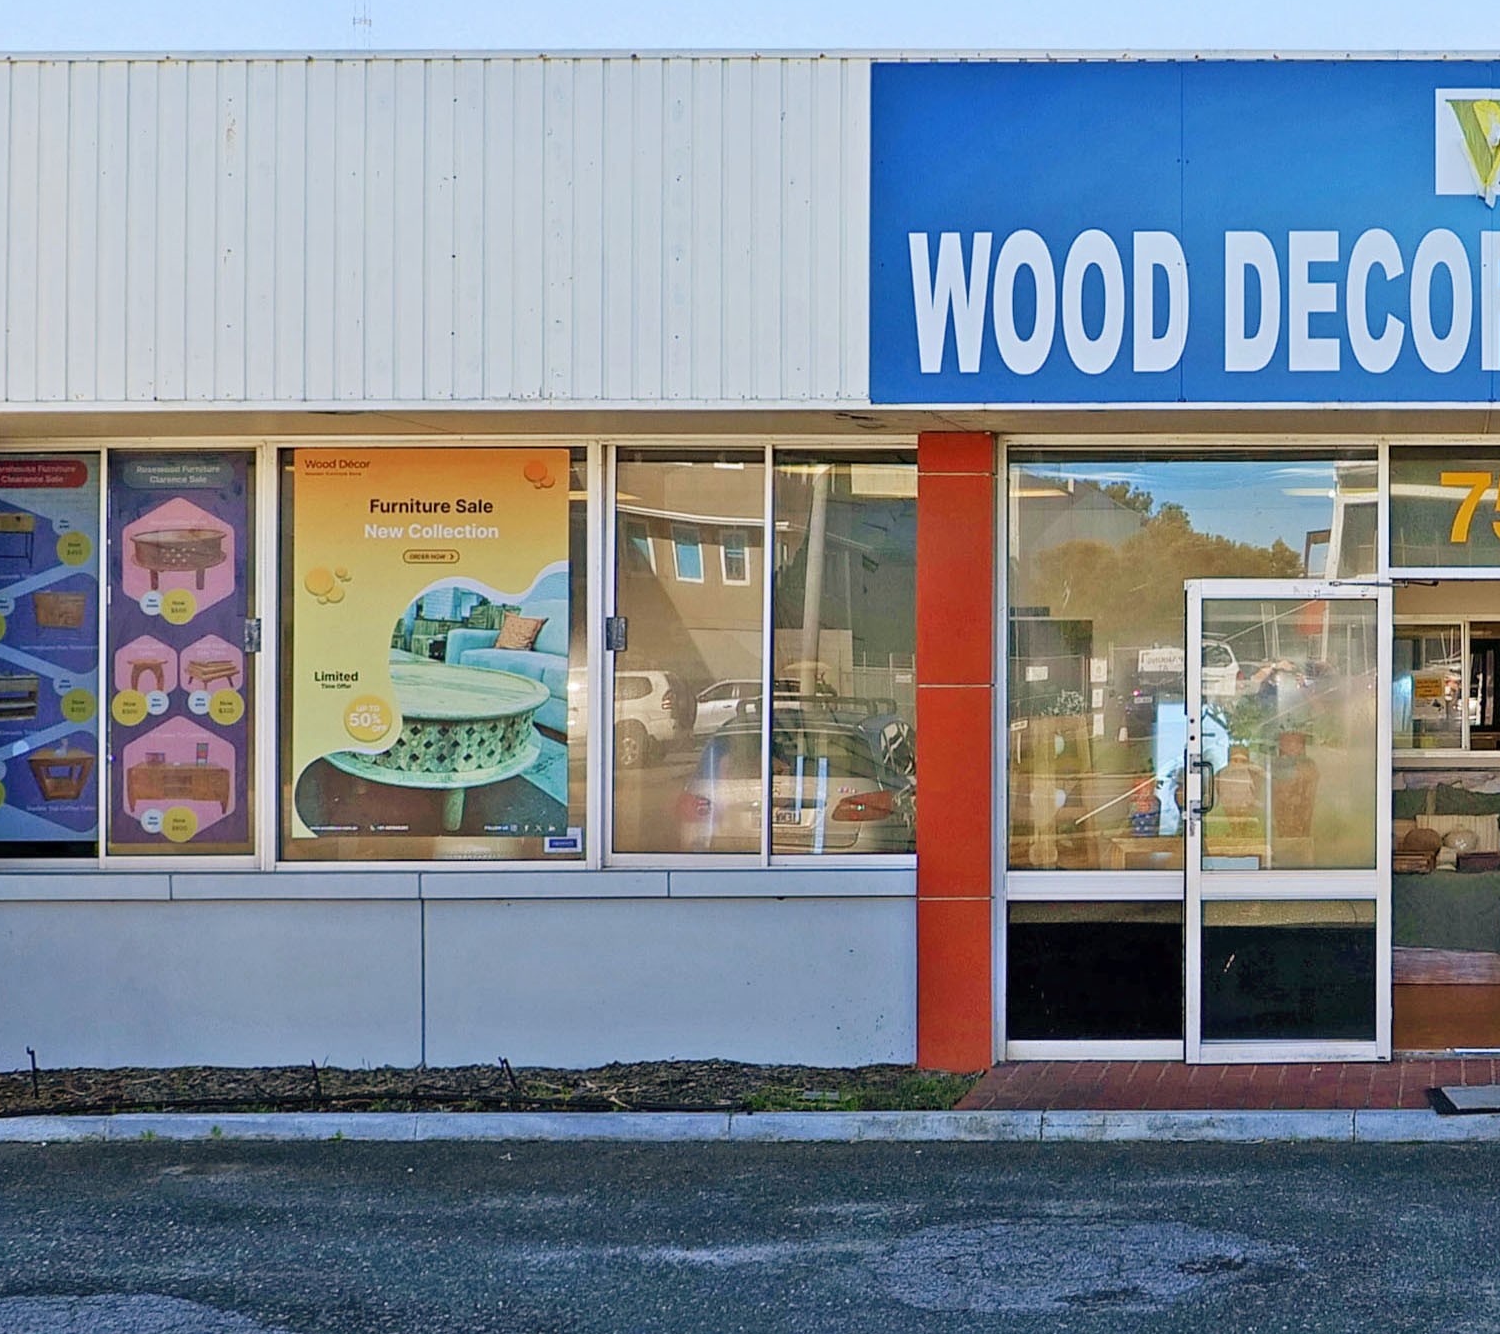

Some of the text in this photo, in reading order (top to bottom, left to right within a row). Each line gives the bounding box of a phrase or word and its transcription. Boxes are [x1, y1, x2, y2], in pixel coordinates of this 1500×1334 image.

[908, 229, 1189, 375] WOOD
[38, 465, 77, 473] Furniture
[136, 465, 220, 473] Rosewood Furniture
[304, 459, 371, 469] Wood Décor
[1, 475, 64, 483] Clearance Sale
[190, 475, 207, 483] Sale
[370, 497, 494, 513] Furniture Sale
[364, 523, 500, 539] New Collection
[314, 671, 359, 681] Limited
